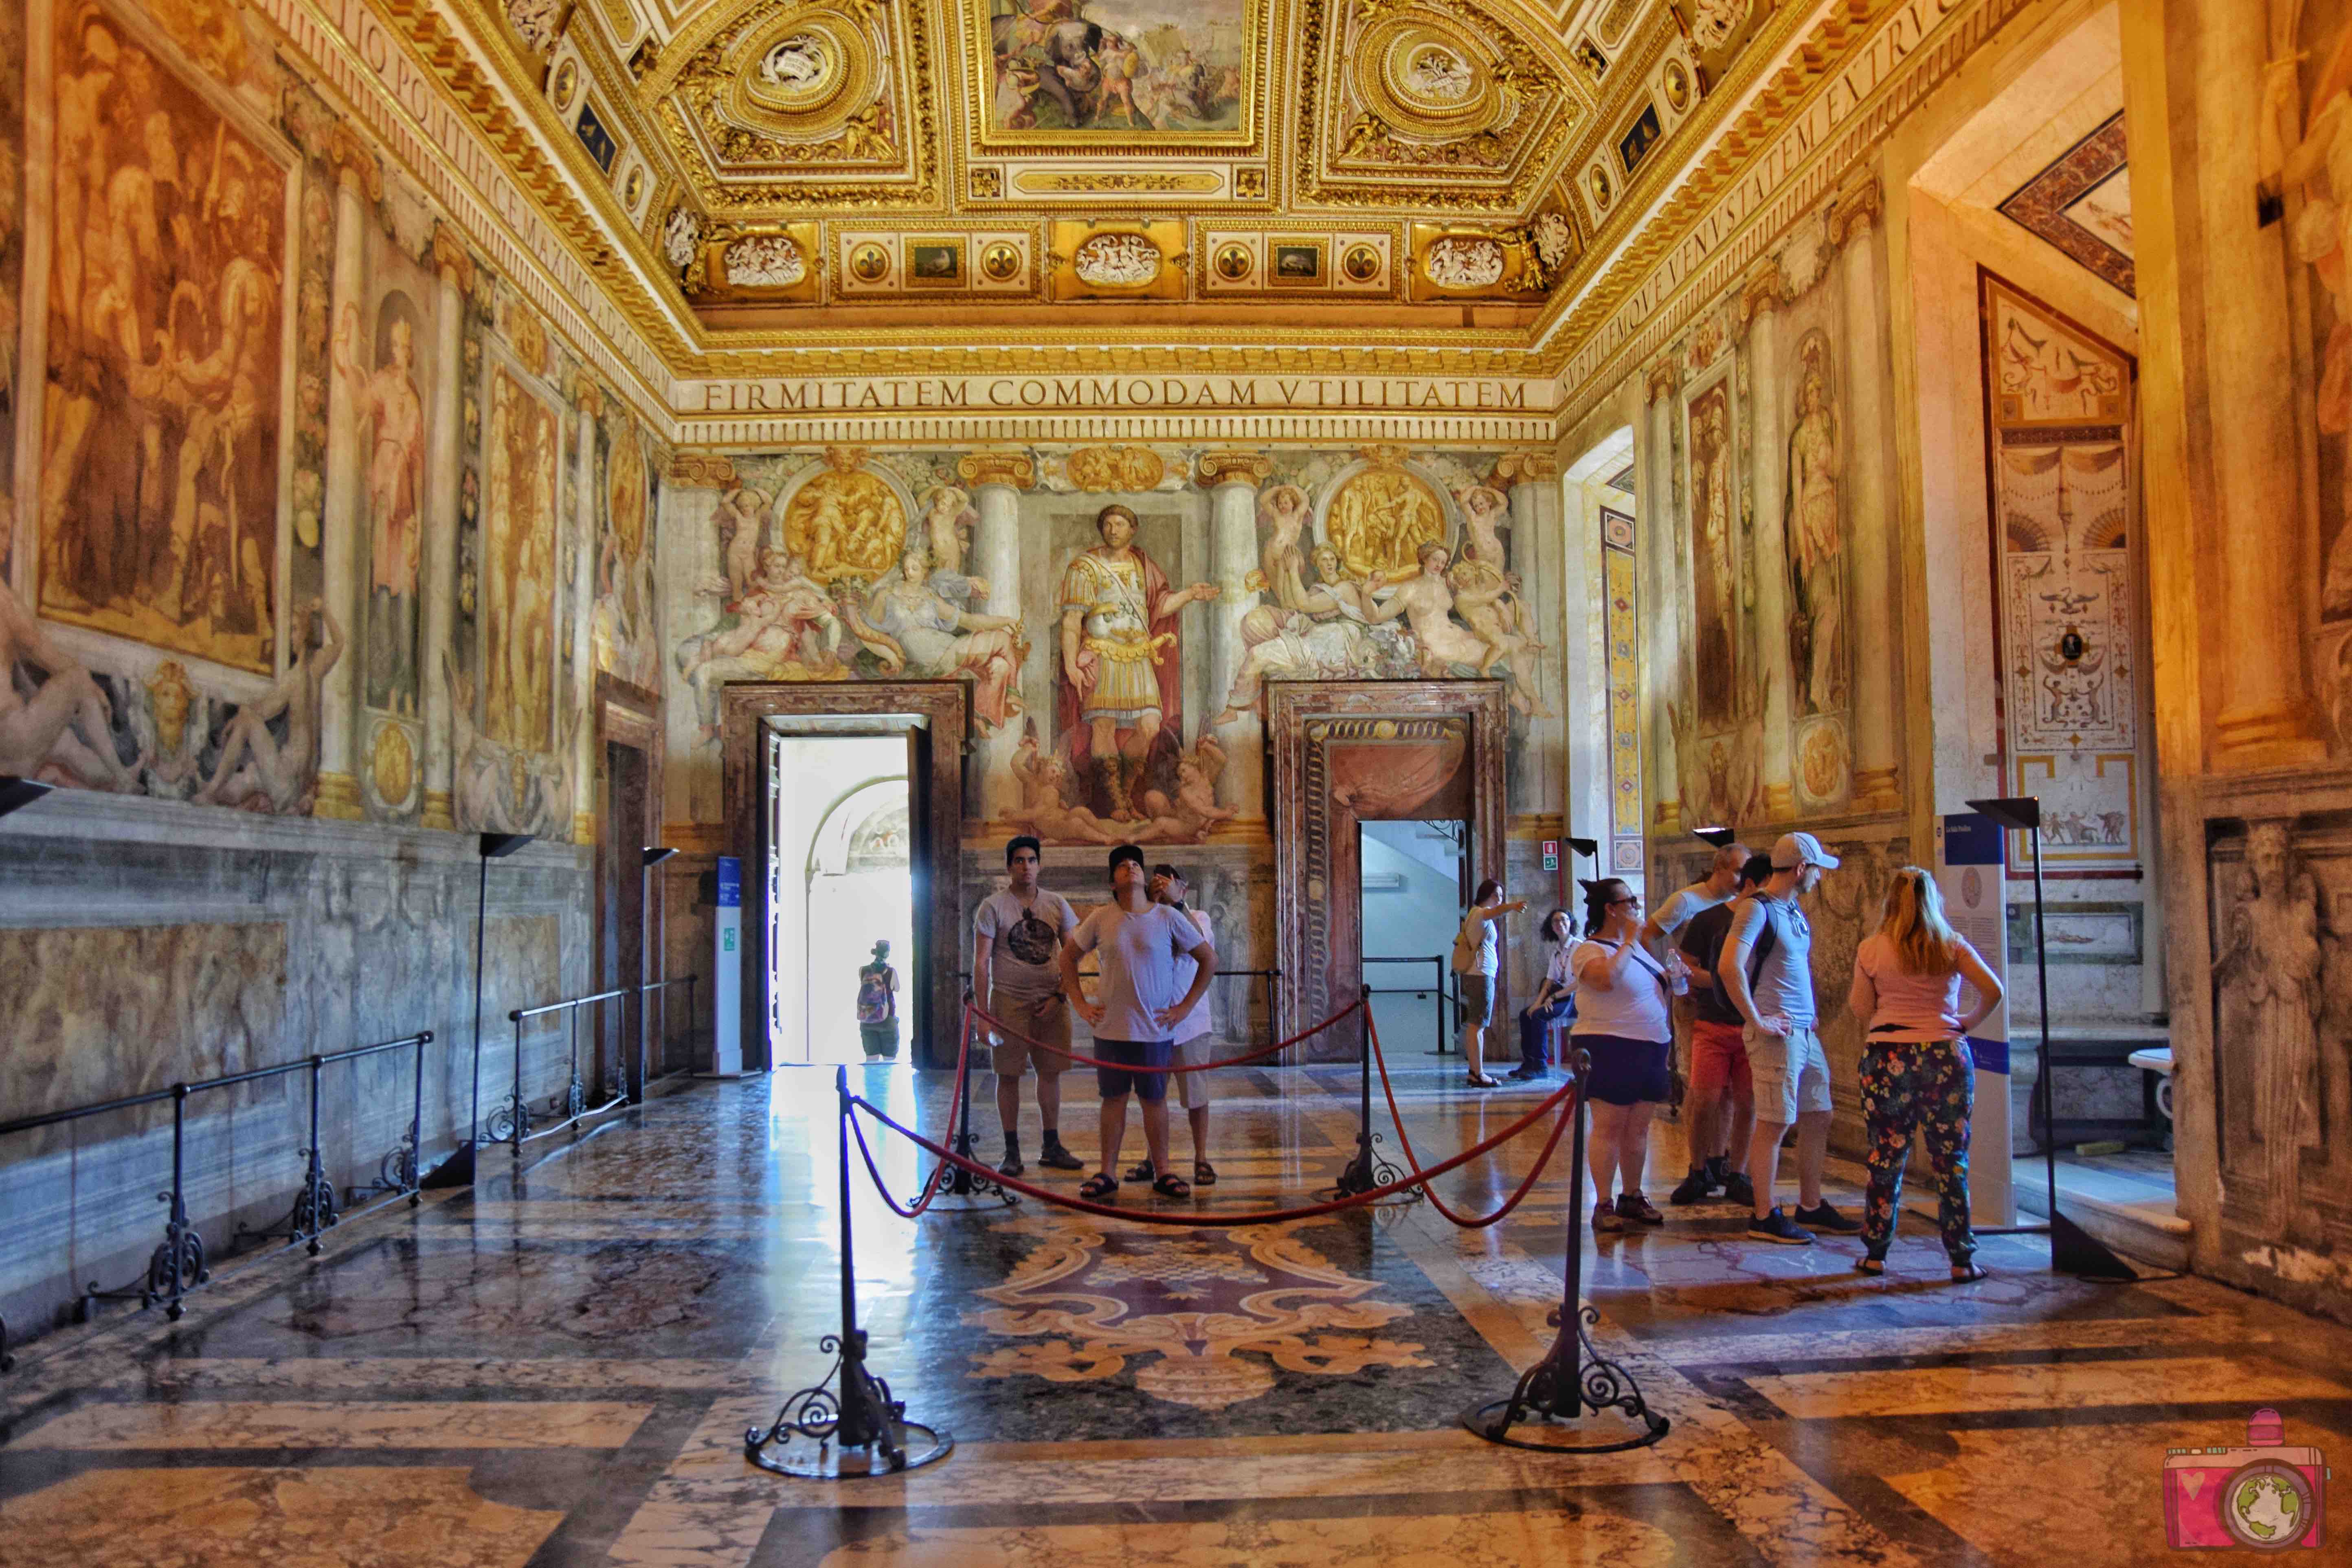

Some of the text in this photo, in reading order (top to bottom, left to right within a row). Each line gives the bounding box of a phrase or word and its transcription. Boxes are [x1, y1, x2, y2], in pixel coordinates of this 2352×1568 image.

[394, 54, 516, 229] PONTIFICE
[523, 206, 593, 314] MAXIMO
[1669, 109, 1816, 285] VENVSTATEM
[704, 379, 1527, 410] FIRMITATEM COMMODAM VTILITATEM
